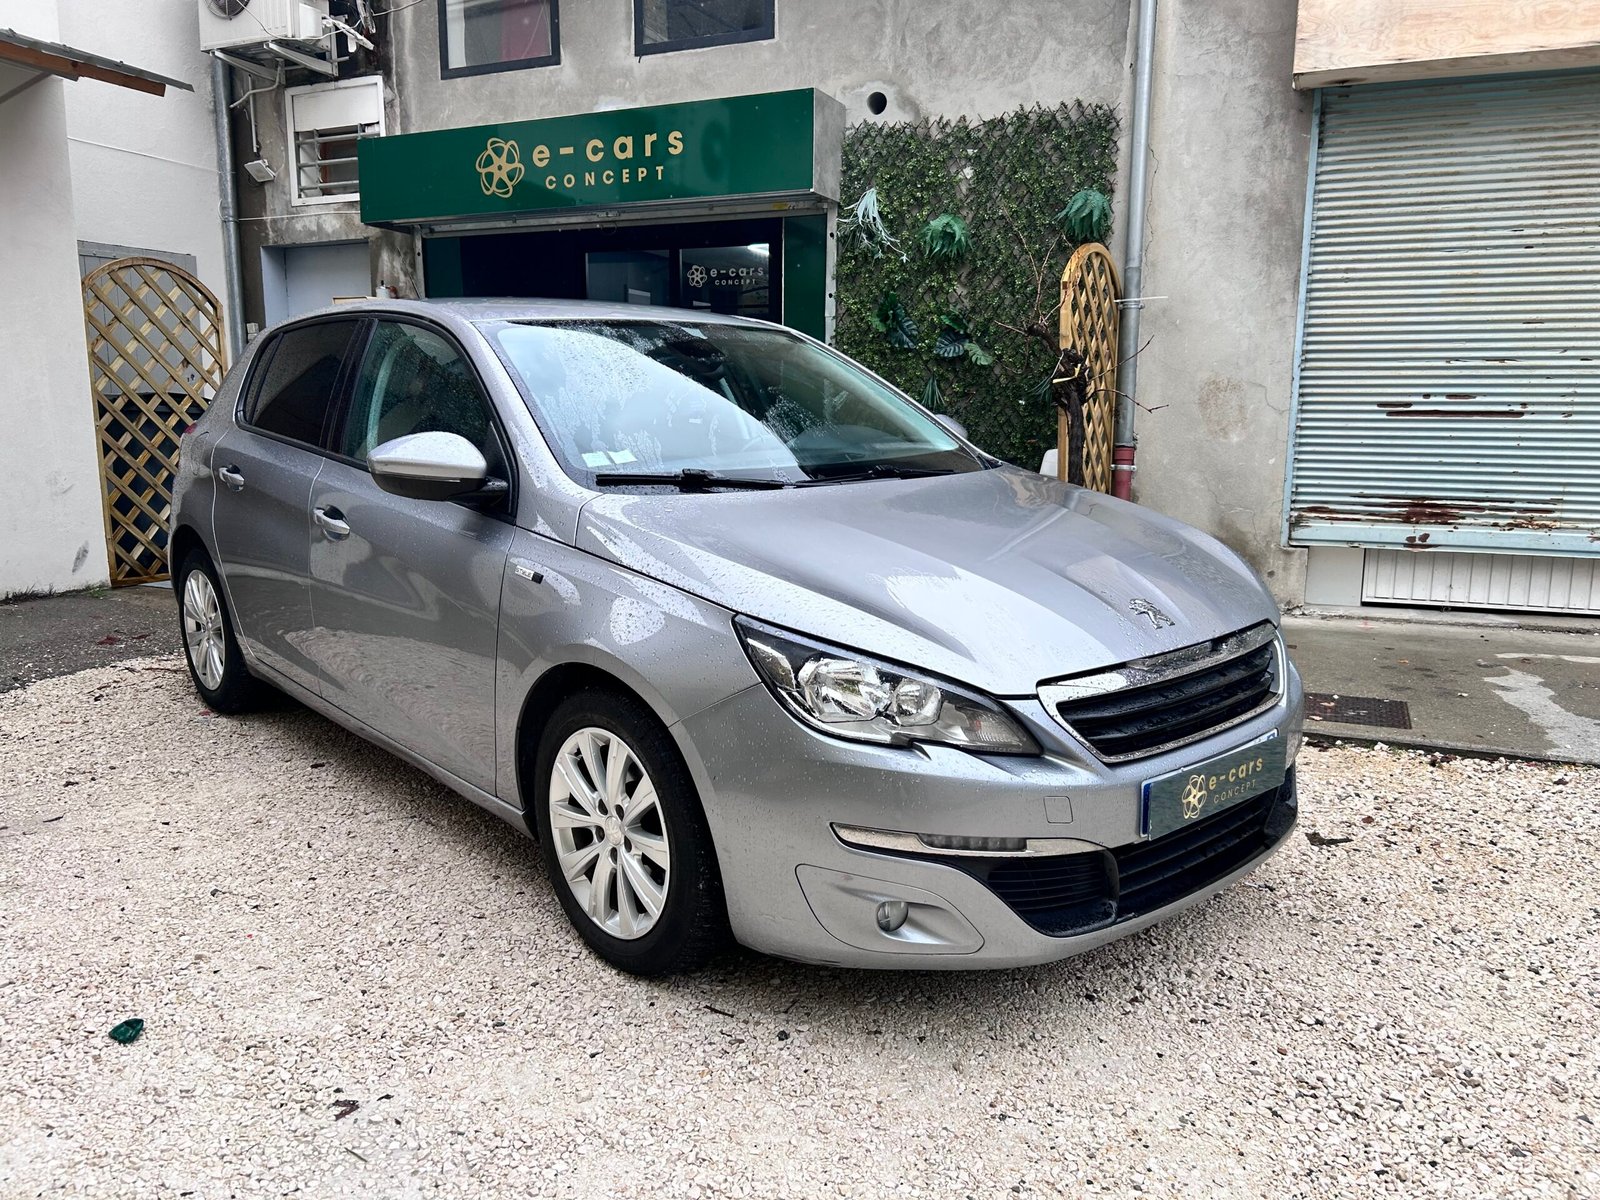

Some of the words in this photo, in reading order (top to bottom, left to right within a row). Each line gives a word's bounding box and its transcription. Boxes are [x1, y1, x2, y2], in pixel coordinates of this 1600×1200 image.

[532, 130, 684, 167] e-cars
[545, 165, 664, 190] CONCEPT
[710, 267, 764, 277] e-cars
